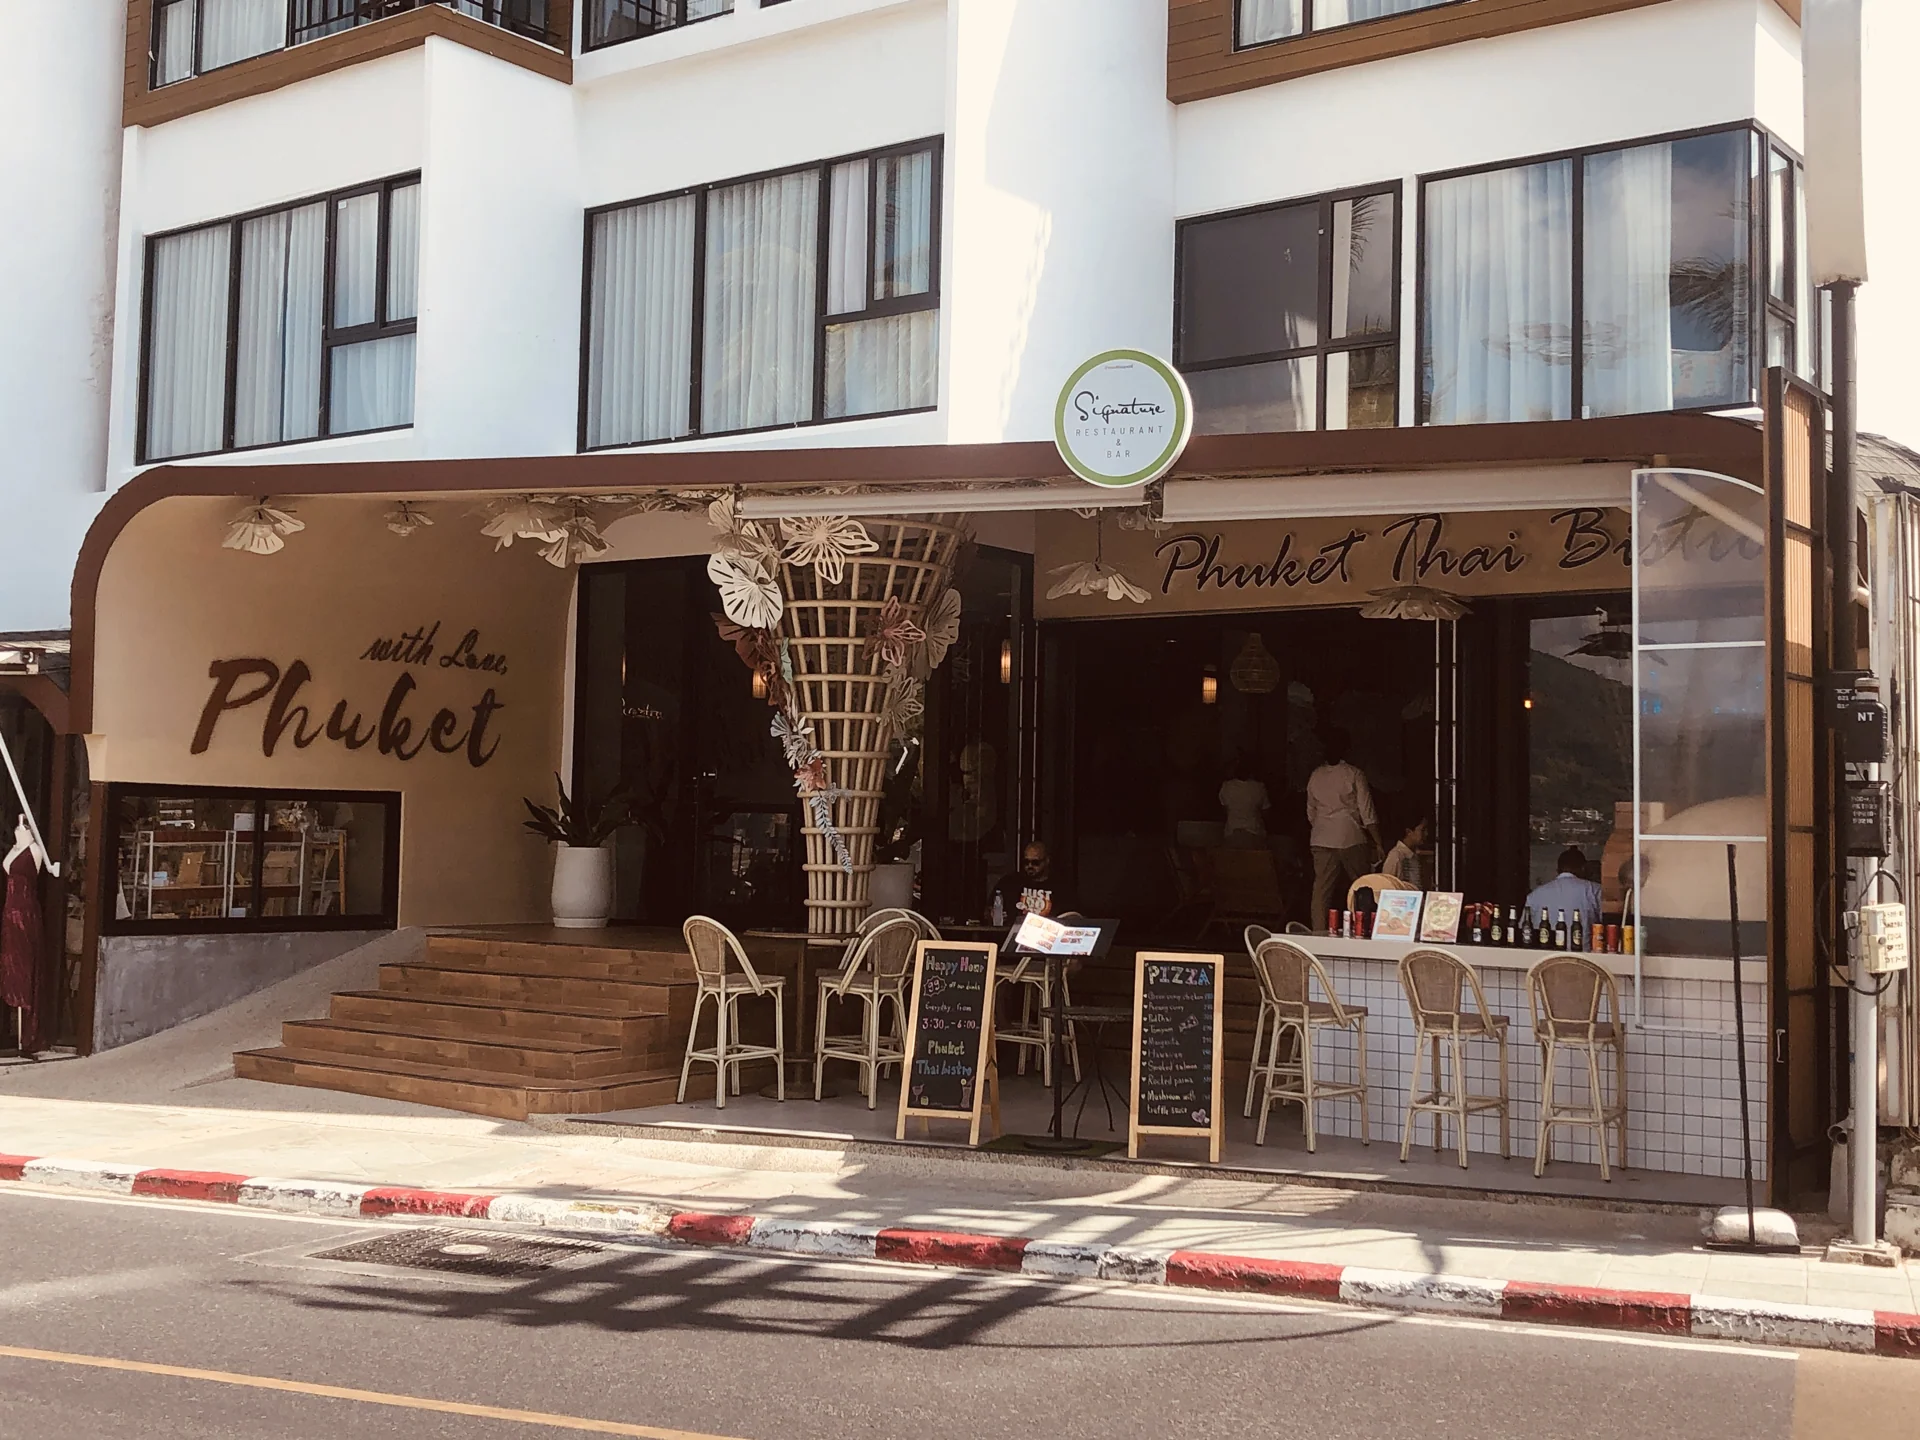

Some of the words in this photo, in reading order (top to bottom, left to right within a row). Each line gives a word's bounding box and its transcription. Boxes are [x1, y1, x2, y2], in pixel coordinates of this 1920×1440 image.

[1074, 391, 1165, 424] Signature
[1075, 425, 1163, 437] RESTAURANT
[1115, 438, 1122, 446] &
[1106, 449, 1131, 459] BAR
[1154, 529, 1367, 594] Phuket
[1382, 512, 1526, 582] Thai
[359, 620, 441, 666] with
[190, 657, 504, 768] Phuket
[1857, 711, 1875, 722] NT
[1021, 887, 1052, 900] JUST
[925, 955, 958, 976] Happy
[959, 956, 985, 973] Hour
[1147, 965, 1211, 986] PIZZA
[927, 1039, 965, 1056] Phuket
